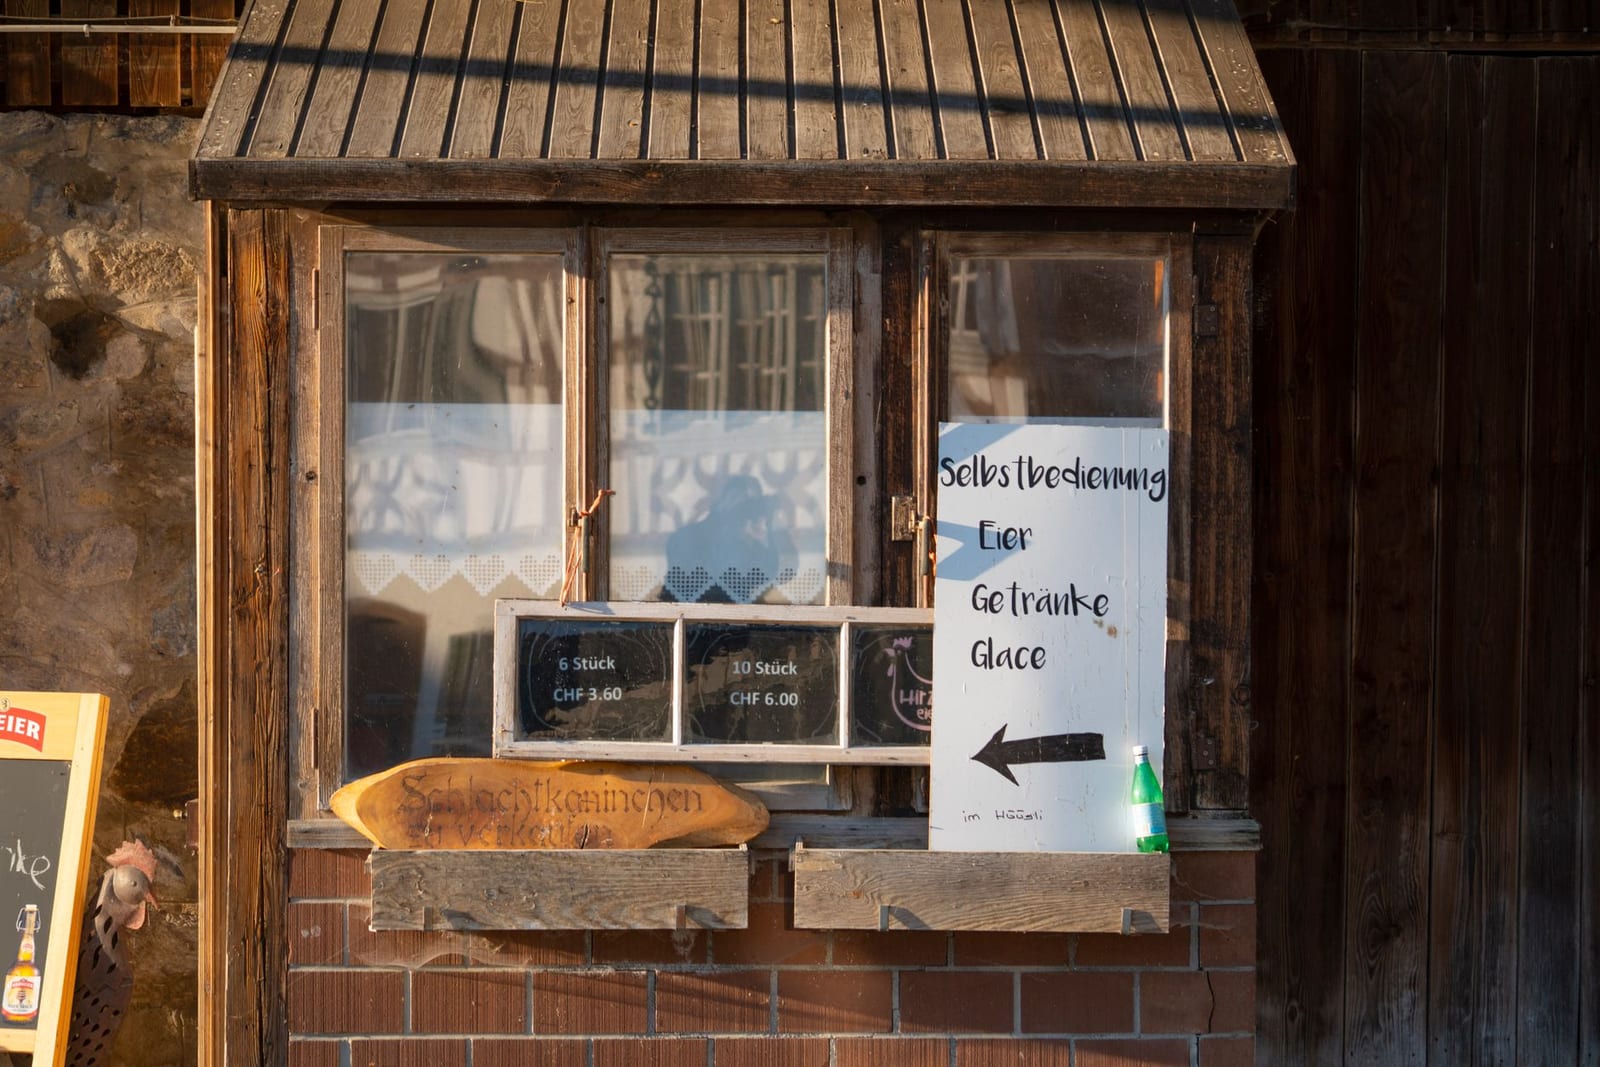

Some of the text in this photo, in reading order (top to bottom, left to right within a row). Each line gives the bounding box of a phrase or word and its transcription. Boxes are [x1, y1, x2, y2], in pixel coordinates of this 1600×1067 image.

[940, 455, 1167, 502] Selbstbedienung
[979, 520, 1033, 550] Eier
[971, 582, 1109, 617] Getränke
[559, 655, 616, 671] 6 Stück
[971, 637, 1047, 670] Glace
[732, 661, 798, 676] 10 Stück
[553, 687, 622, 702] CHF 3.60
[730, 692, 799, 706] CHF 6.00
[397, 772, 703, 829] Schlachtkaninchen
[962, 810, 981, 823] im
